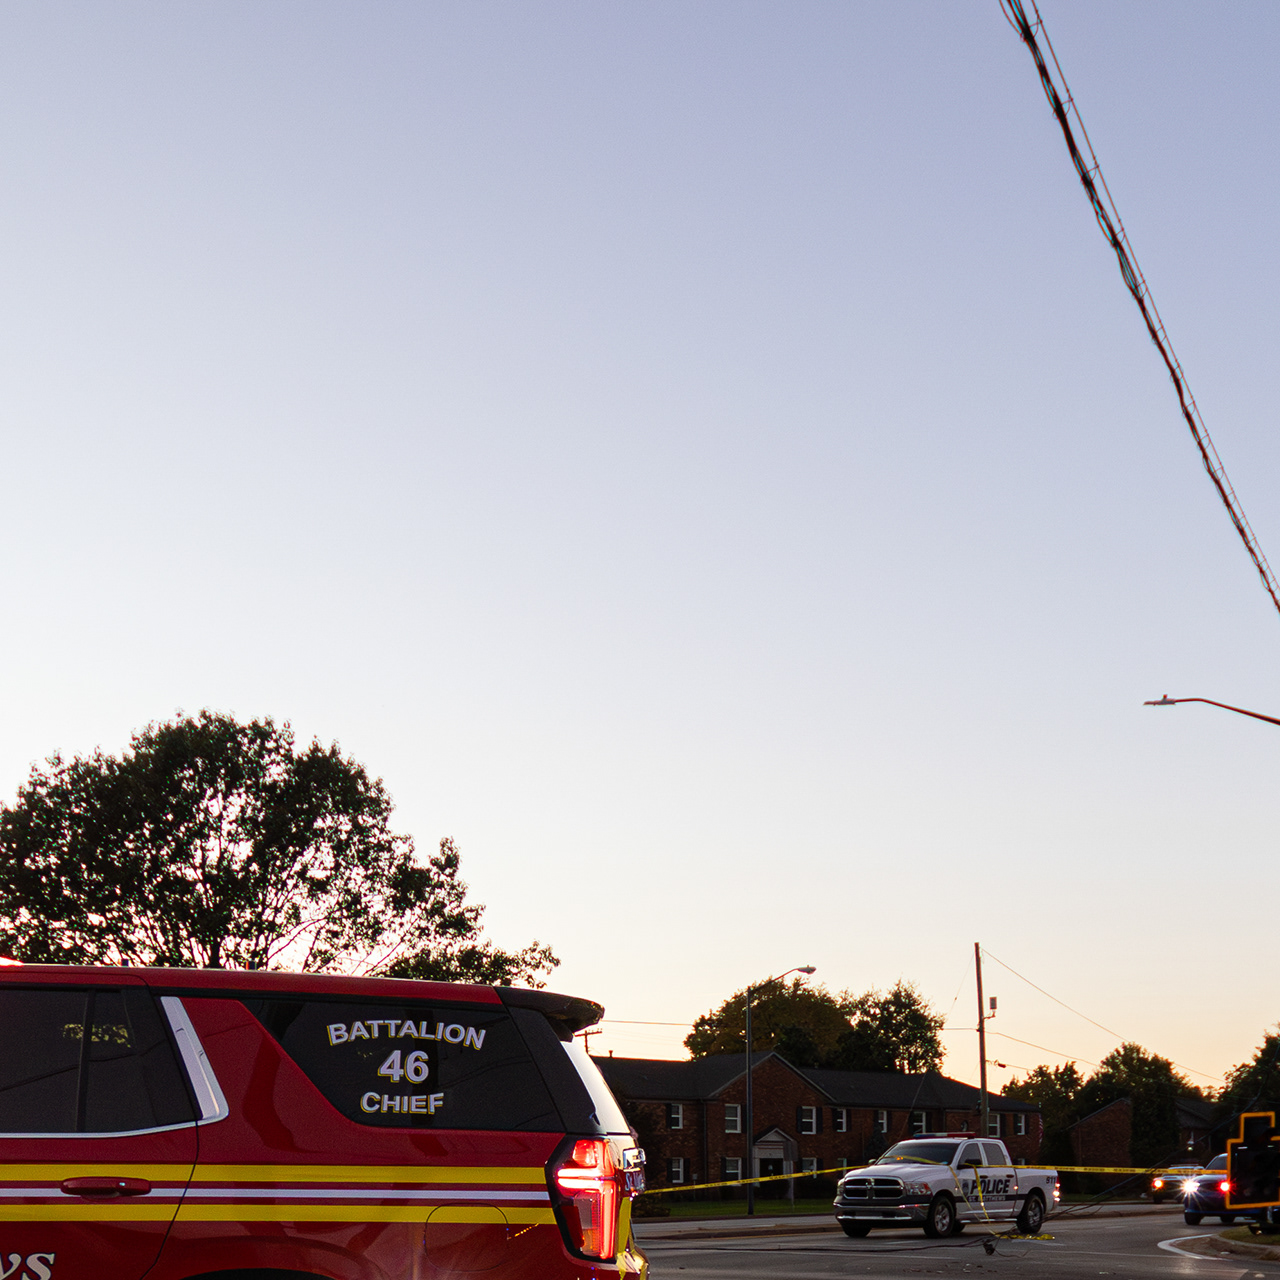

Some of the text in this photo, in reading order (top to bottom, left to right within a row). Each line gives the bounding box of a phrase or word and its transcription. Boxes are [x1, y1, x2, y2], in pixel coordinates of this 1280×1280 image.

[327, 1020, 486, 1050] BATTALION
[377, 1050, 429, 1084] 46
[360, 1092, 444, 1115] CHIEF
[970, 1179, 1011, 1195] POLICE
